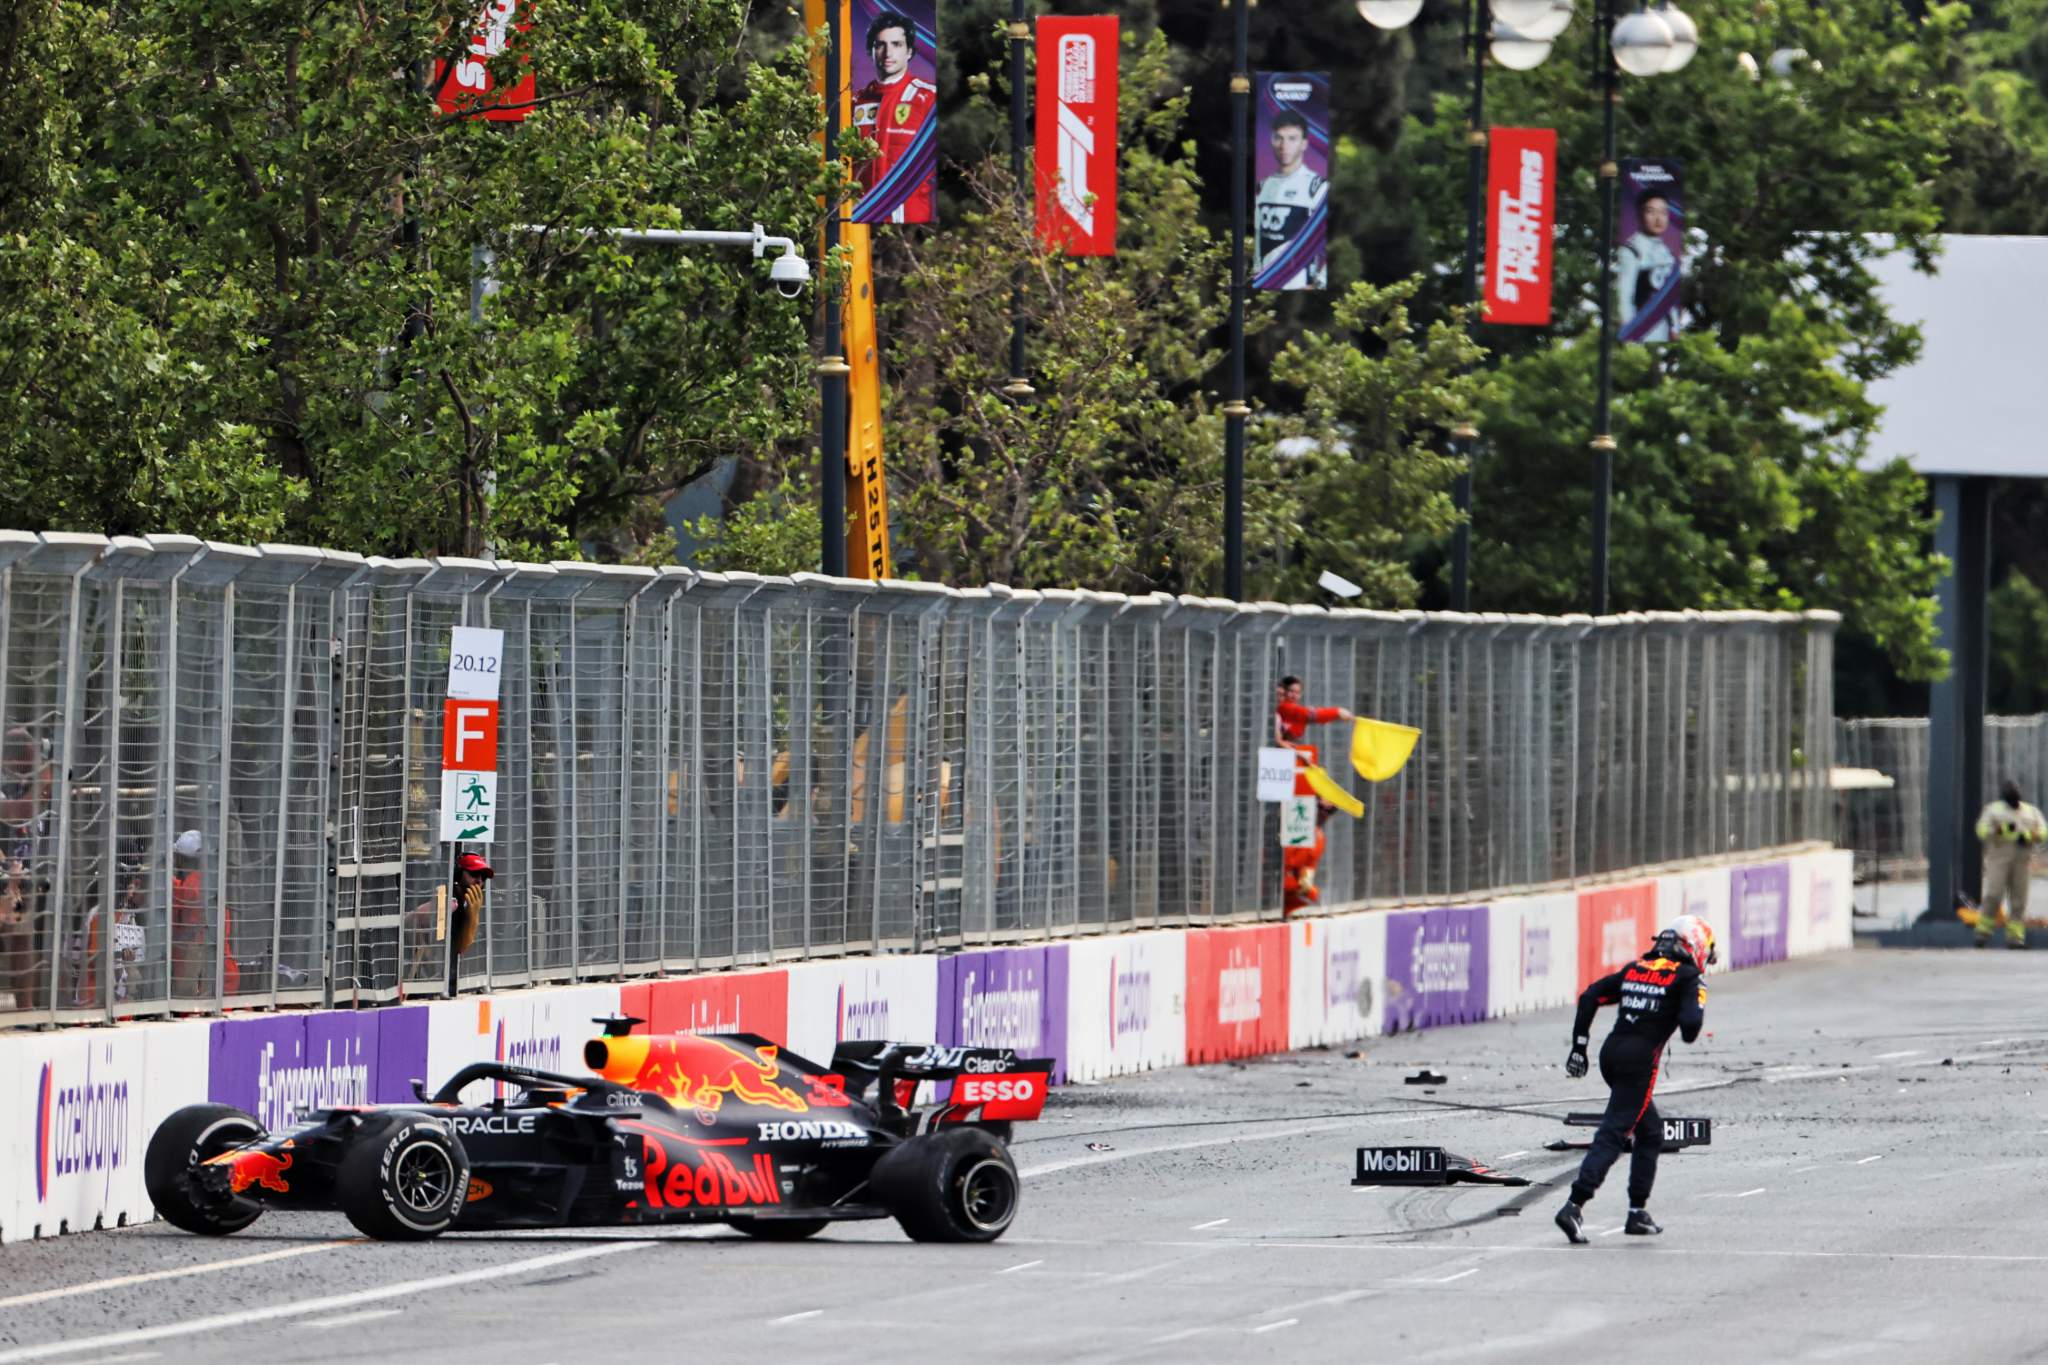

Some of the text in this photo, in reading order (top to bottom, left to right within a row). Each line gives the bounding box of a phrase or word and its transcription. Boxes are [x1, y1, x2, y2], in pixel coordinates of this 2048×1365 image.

[453, 654, 497, 673] 20.12
[456, 707, 489, 762] F
[1621, 981, 1666, 995] HONDA
[965, 1056, 1006, 1073] Claro
[964, 1080, 1033, 1101] ESSO
[56, 1040, 128, 1210] azerbaijan
[758, 1121, 868, 1141] HONDA
[1663, 1120, 1684, 1140] bil
[380, 1126, 410, 1182] ZERO
[1364, 1150, 1436, 1171] Mobil 1
